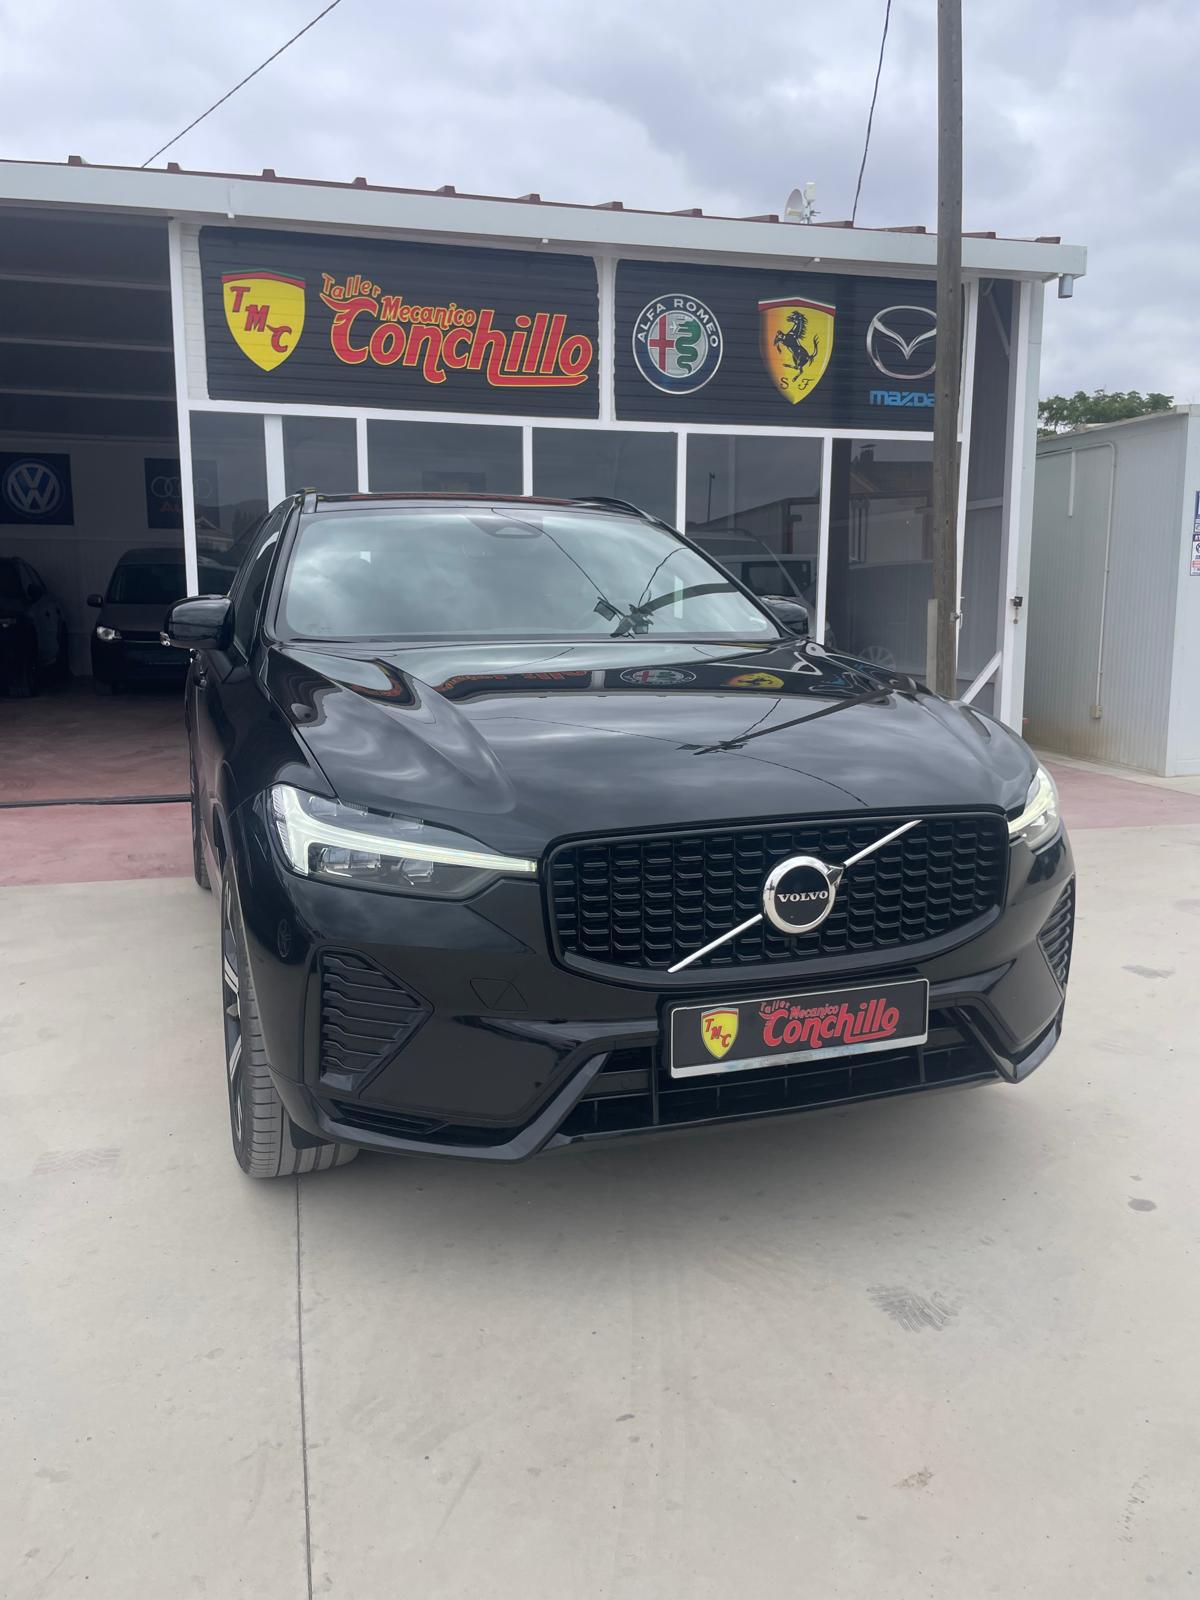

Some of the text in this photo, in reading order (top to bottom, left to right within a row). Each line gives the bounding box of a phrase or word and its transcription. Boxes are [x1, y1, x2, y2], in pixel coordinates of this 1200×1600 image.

[320, 272, 476, 329] Taller Mecanico
[637, 298, 719, 347] ALFA ROMEO
[319, 292, 593, 387] Conchillo
[777, 891, 828, 903] VOLVO
[759, 998, 900, 1048] Conchillo
[760, 1000, 791, 1014] Taller
